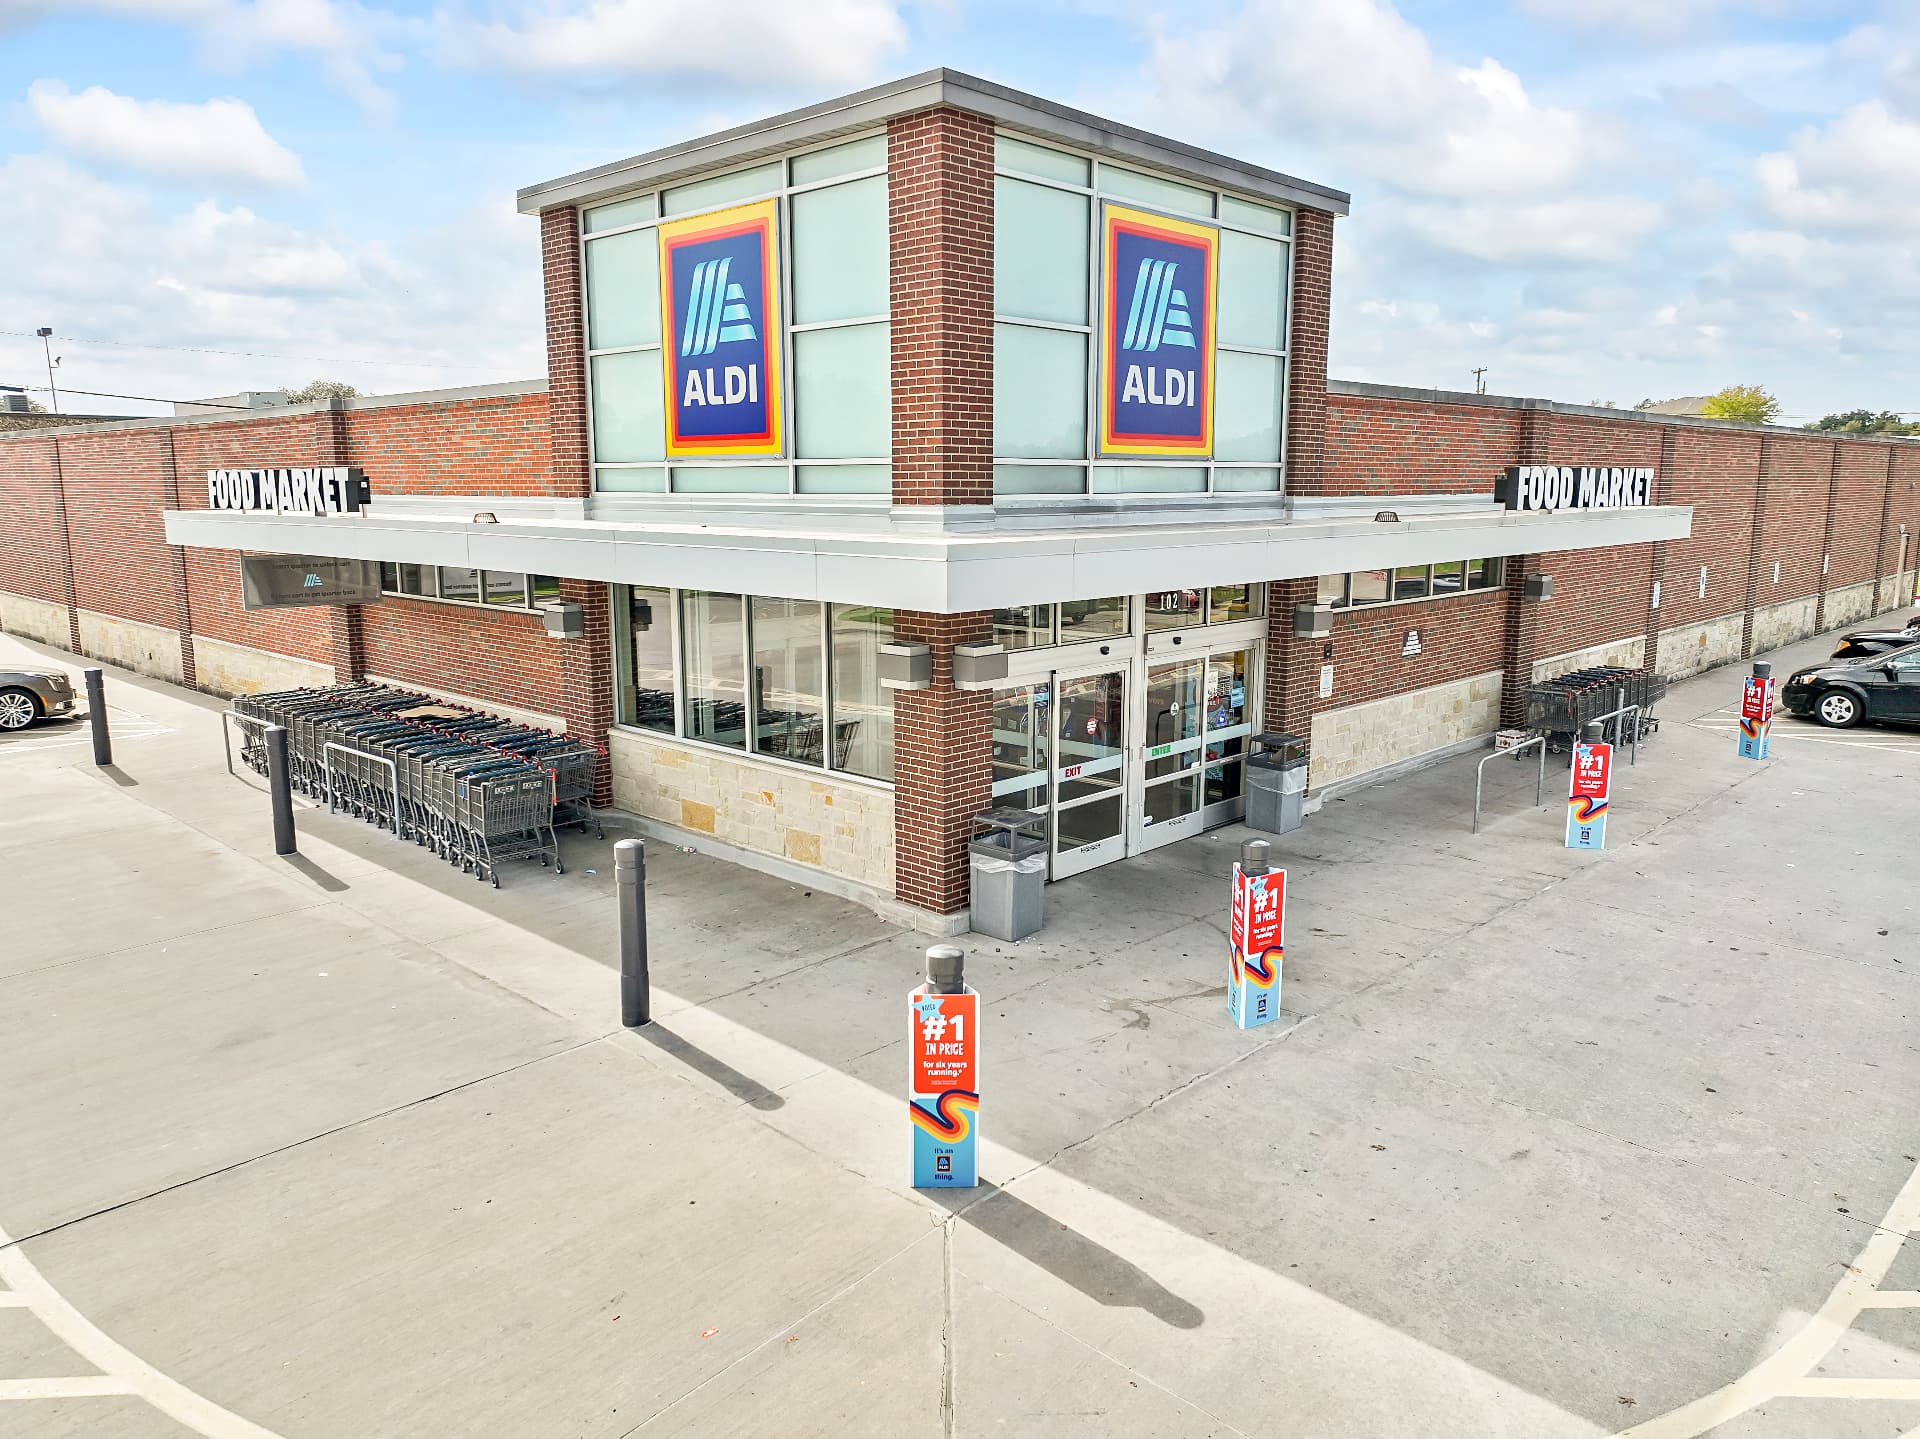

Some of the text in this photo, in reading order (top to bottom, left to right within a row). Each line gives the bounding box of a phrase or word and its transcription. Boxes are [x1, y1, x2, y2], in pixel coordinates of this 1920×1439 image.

[683, 364, 758, 408] ALDI
[1122, 364, 1196, 407] ALDI
[207, 467, 349, 513] FOOD MARKET
[1517, 466, 1655, 510] FOOD MARKET
[1159, 592, 1179, 610] 102
[1151, 744, 1172, 757] ENTER
[1064, 765, 1082, 777] EXIT
[1579, 755, 1604, 770] #1
[1254, 887, 1278, 913] #1
[1263, 909, 1277, 921] PRICE
[922, 1015, 964, 1041] #1
[925, 1042, 964, 1056] IN PRICE
[923, 1060, 968, 1071] for six years
